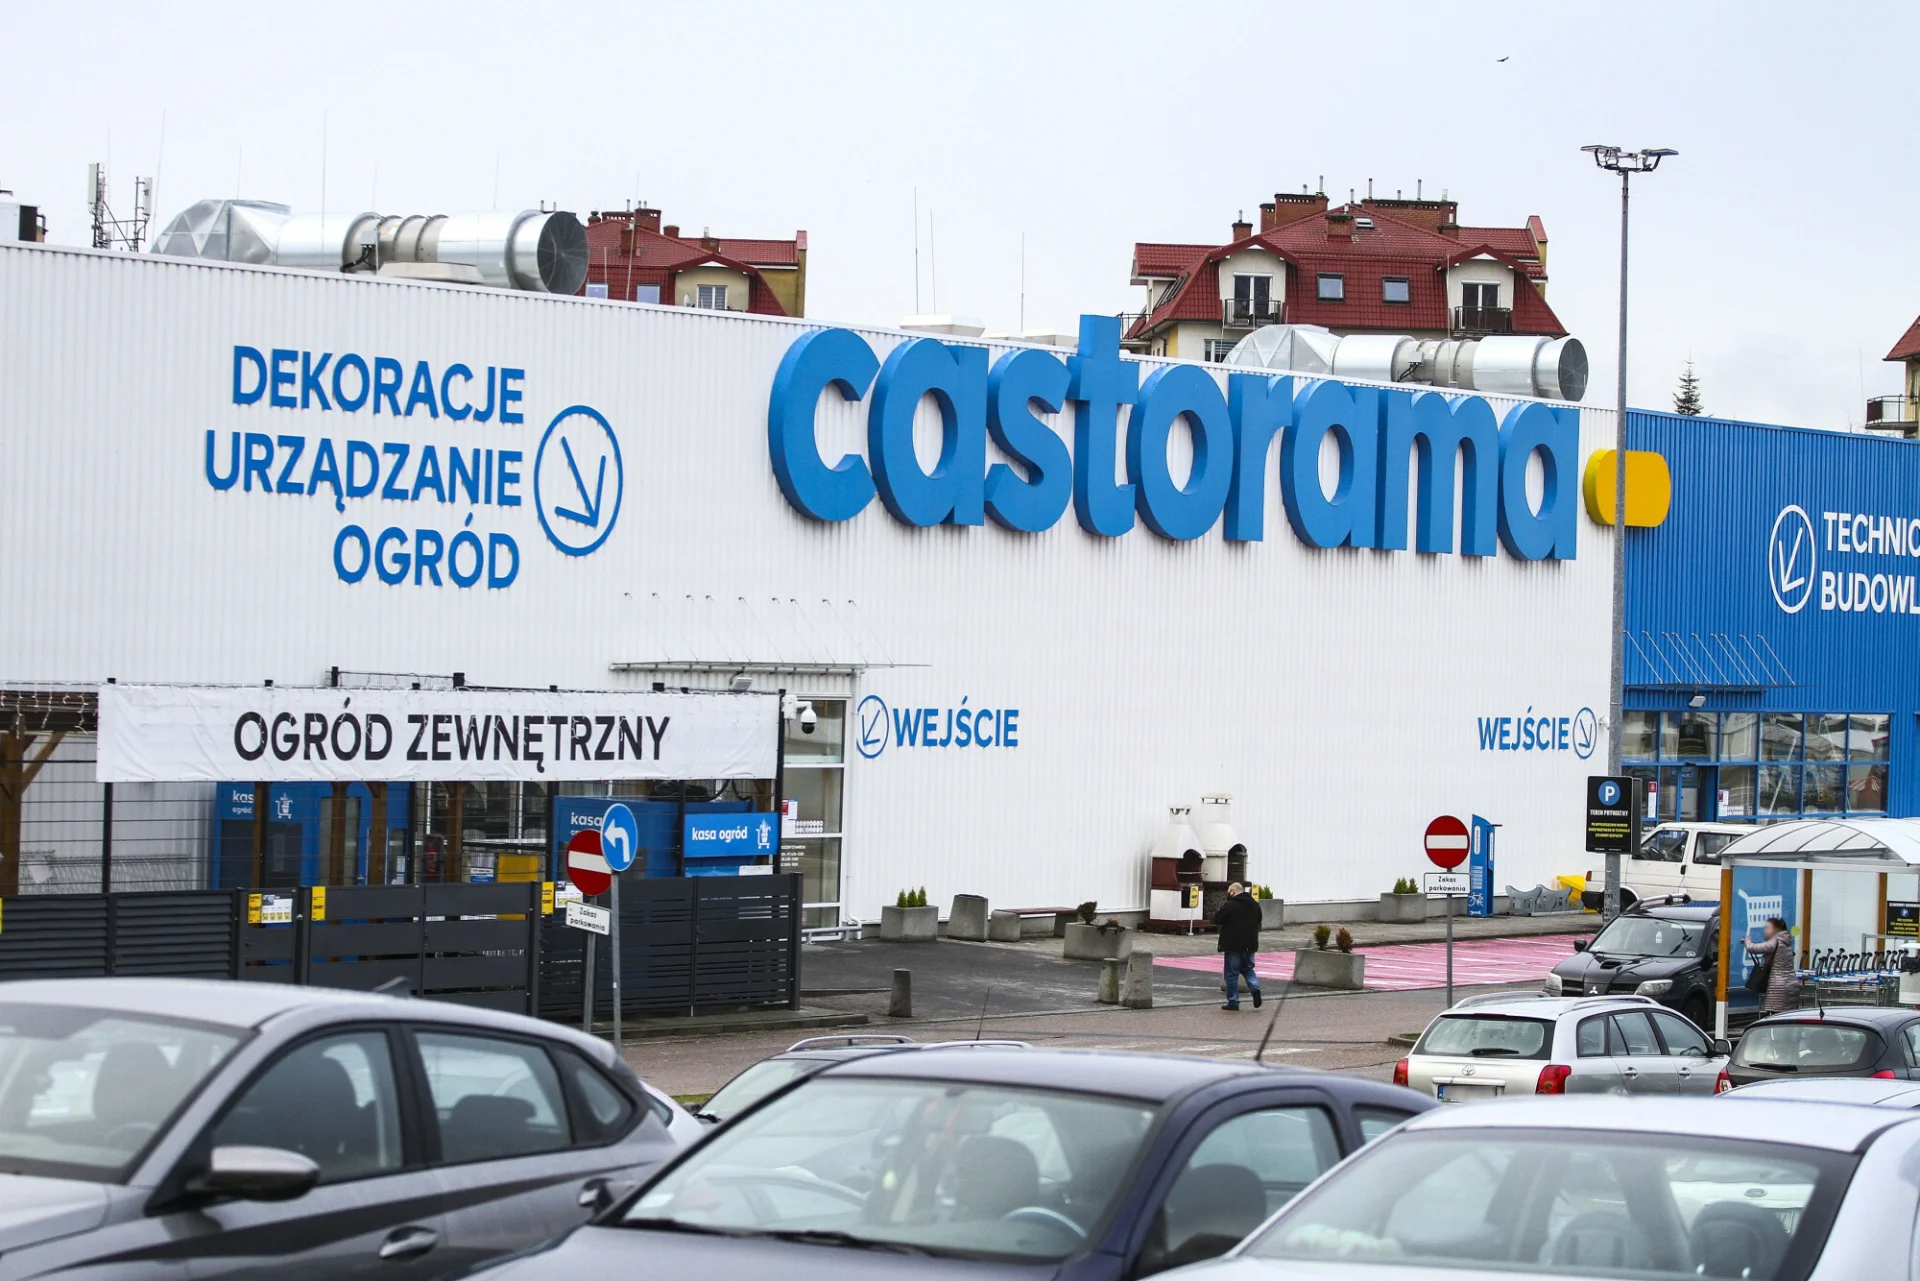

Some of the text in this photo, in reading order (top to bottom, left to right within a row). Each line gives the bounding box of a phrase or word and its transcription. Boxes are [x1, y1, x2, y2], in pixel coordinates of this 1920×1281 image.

[232, 345, 525, 424] DEKORACJE
[769, 314, 1580, 560] castorama
[205, 430, 523, 513] URZĄDZANIE
[333, 512, 520, 590] OGRÓD
[1821, 570, 1920, 615] BUDOWL
[234, 697, 671, 773] OGRÓD ZEWNĘTRZNY
[892, 695, 1019, 748] WEJŚCIE
[1478, 705, 1570, 751] WEJŚCIE
[232, 790, 255, 804] kas
[1604, 785, 1616, 802] P
[692, 825, 748, 843] kasa ogród
[1428, 884, 1466, 892] parkowania
[570, 917, 606, 932] parkowania
[579, 906, 597, 919] Zakaz
